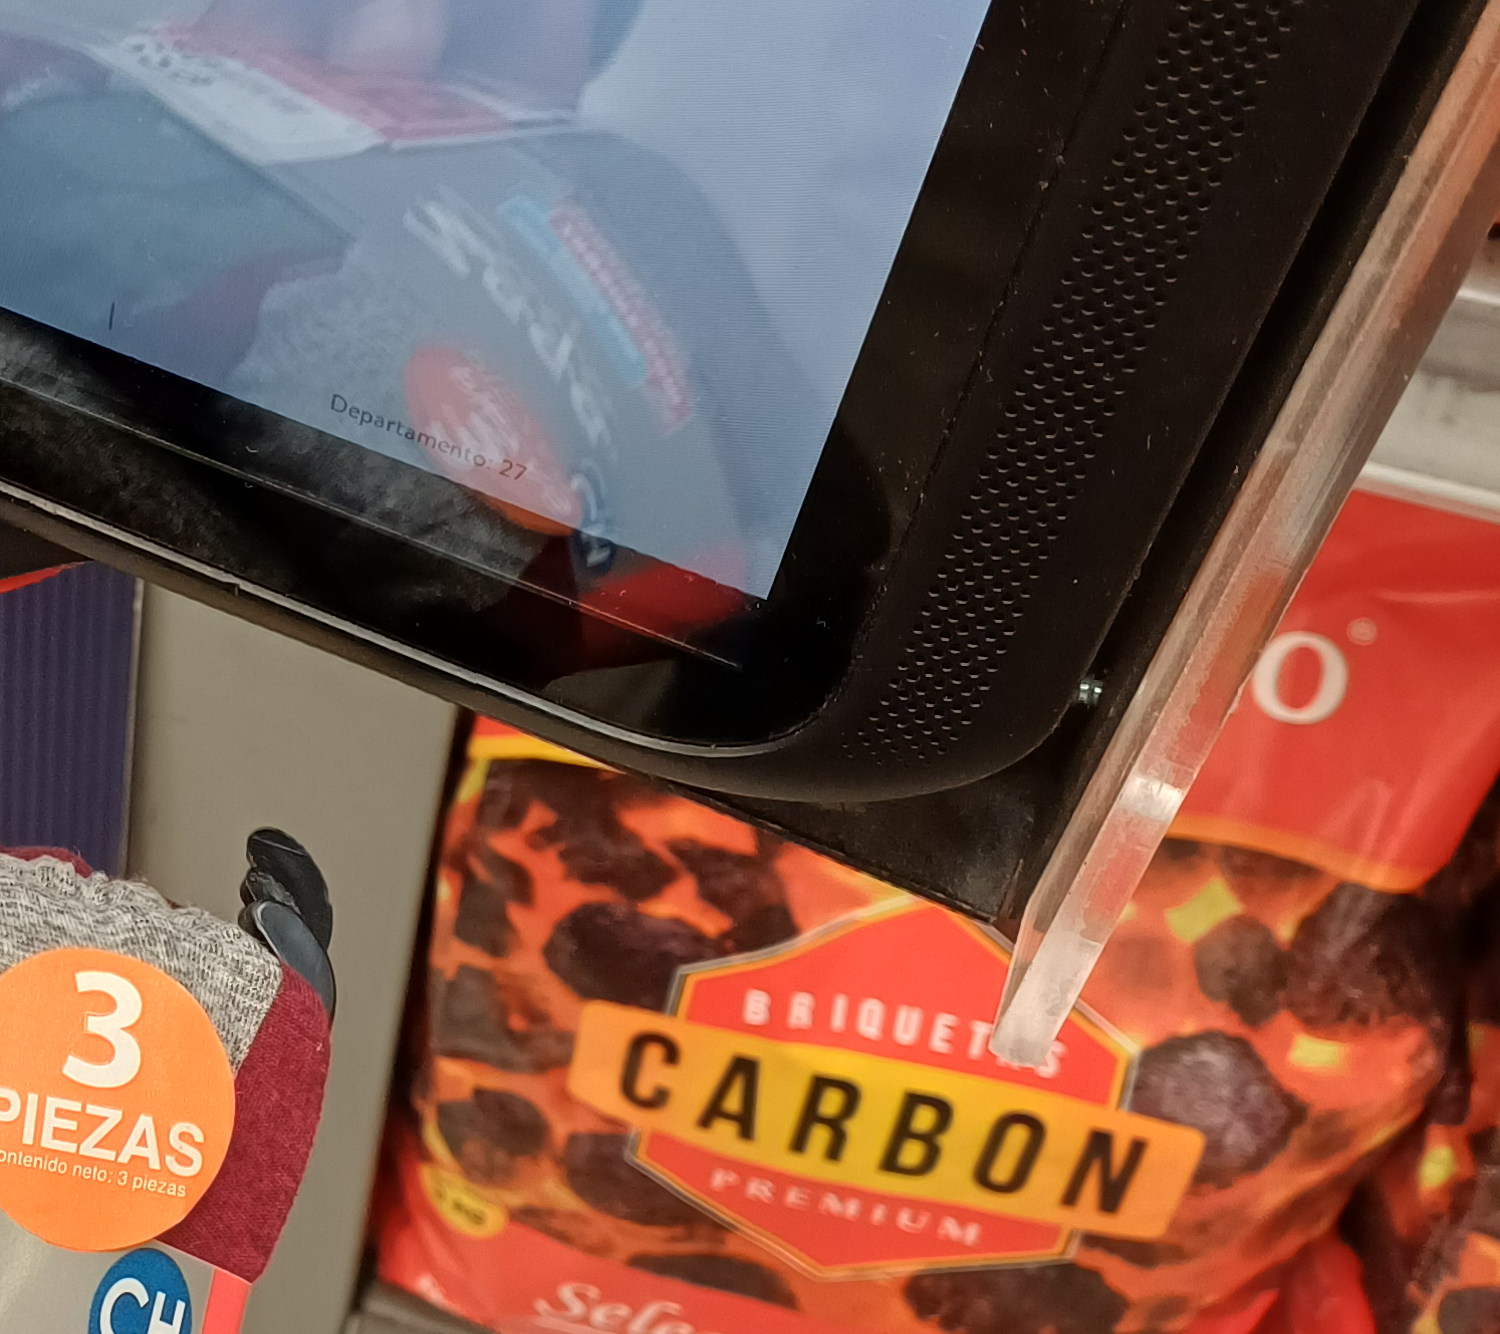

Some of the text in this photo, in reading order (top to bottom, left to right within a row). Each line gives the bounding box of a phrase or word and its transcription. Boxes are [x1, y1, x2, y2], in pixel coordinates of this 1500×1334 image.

[330, 393, 528, 481] Departamento: 27
[60, 969, 144, 1090] 3
[743, 989, 1068, 1079] BRIQUETS
[619, 1031, 1150, 1217] CARBON
[72, 1163, 113, 1185] neto:
[117, 1170, 129, 1188] 3
[131, 1174, 187, 1199] piezas
[708, 1167, 982, 1247] PREMIUM
